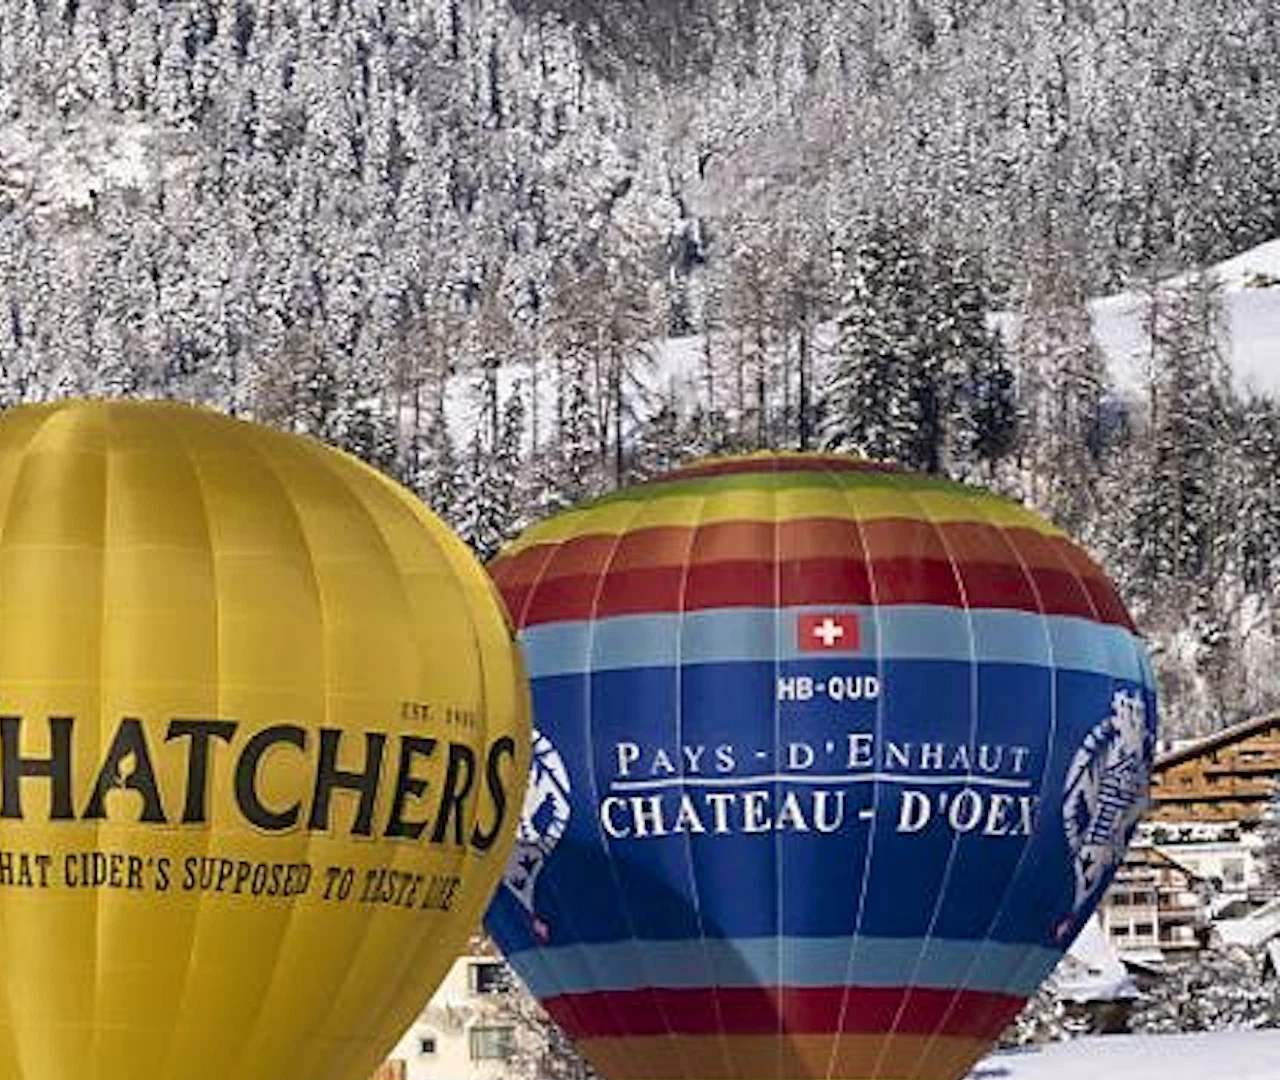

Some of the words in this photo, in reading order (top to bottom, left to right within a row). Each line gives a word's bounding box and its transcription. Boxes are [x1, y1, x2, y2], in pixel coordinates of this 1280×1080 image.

[600, 789, 846, 839] CHATEAU
[896, 787, 1040, 836] D'OEX
[65, 852, 171, 892] CIDER'S
[182, 856, 313, 898] SUPPOSED
[322, 866, 354, 901] TO
